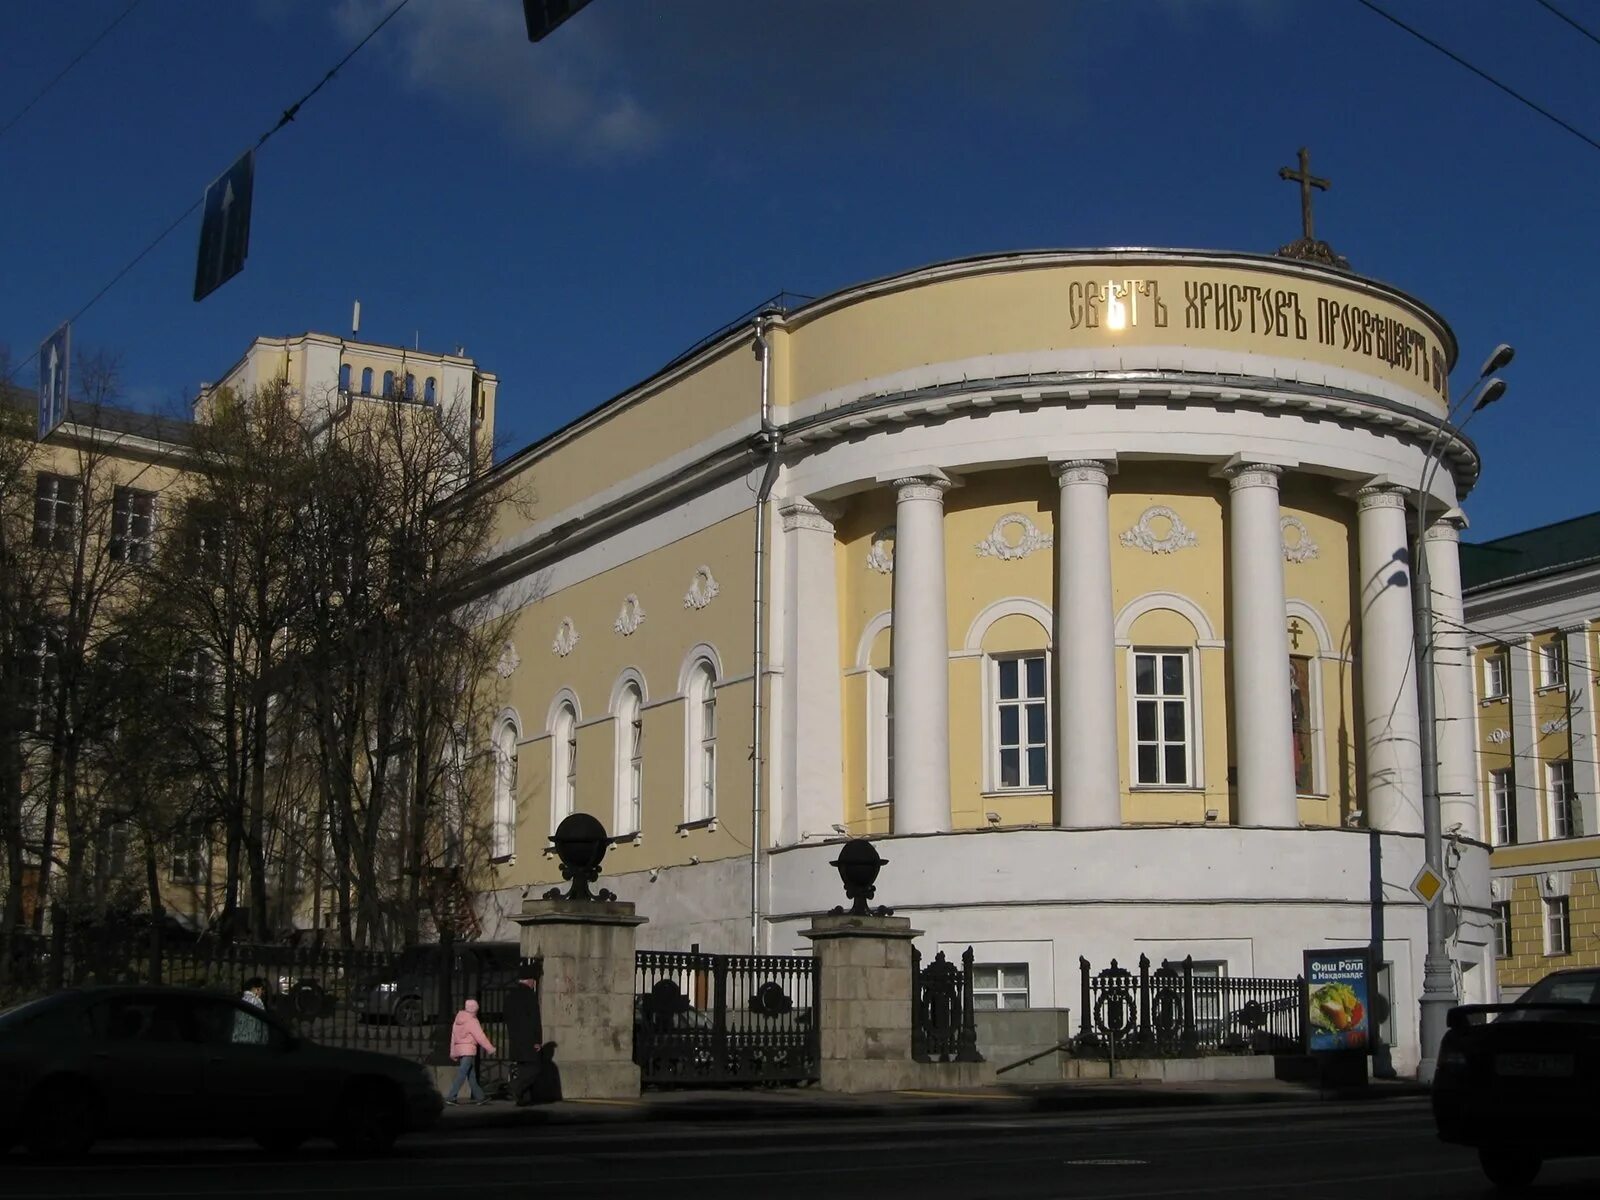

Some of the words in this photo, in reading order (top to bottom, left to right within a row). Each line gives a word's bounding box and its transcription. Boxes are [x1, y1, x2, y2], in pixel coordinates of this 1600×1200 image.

[1184, 281, 1307, 340] ХРИСТОВЪ
[1312, 961, 1337, 972] Фиш
[1338, 961, 1363, 971] Ролл
[1318, 972, 1364, 980] Макдоналдс
